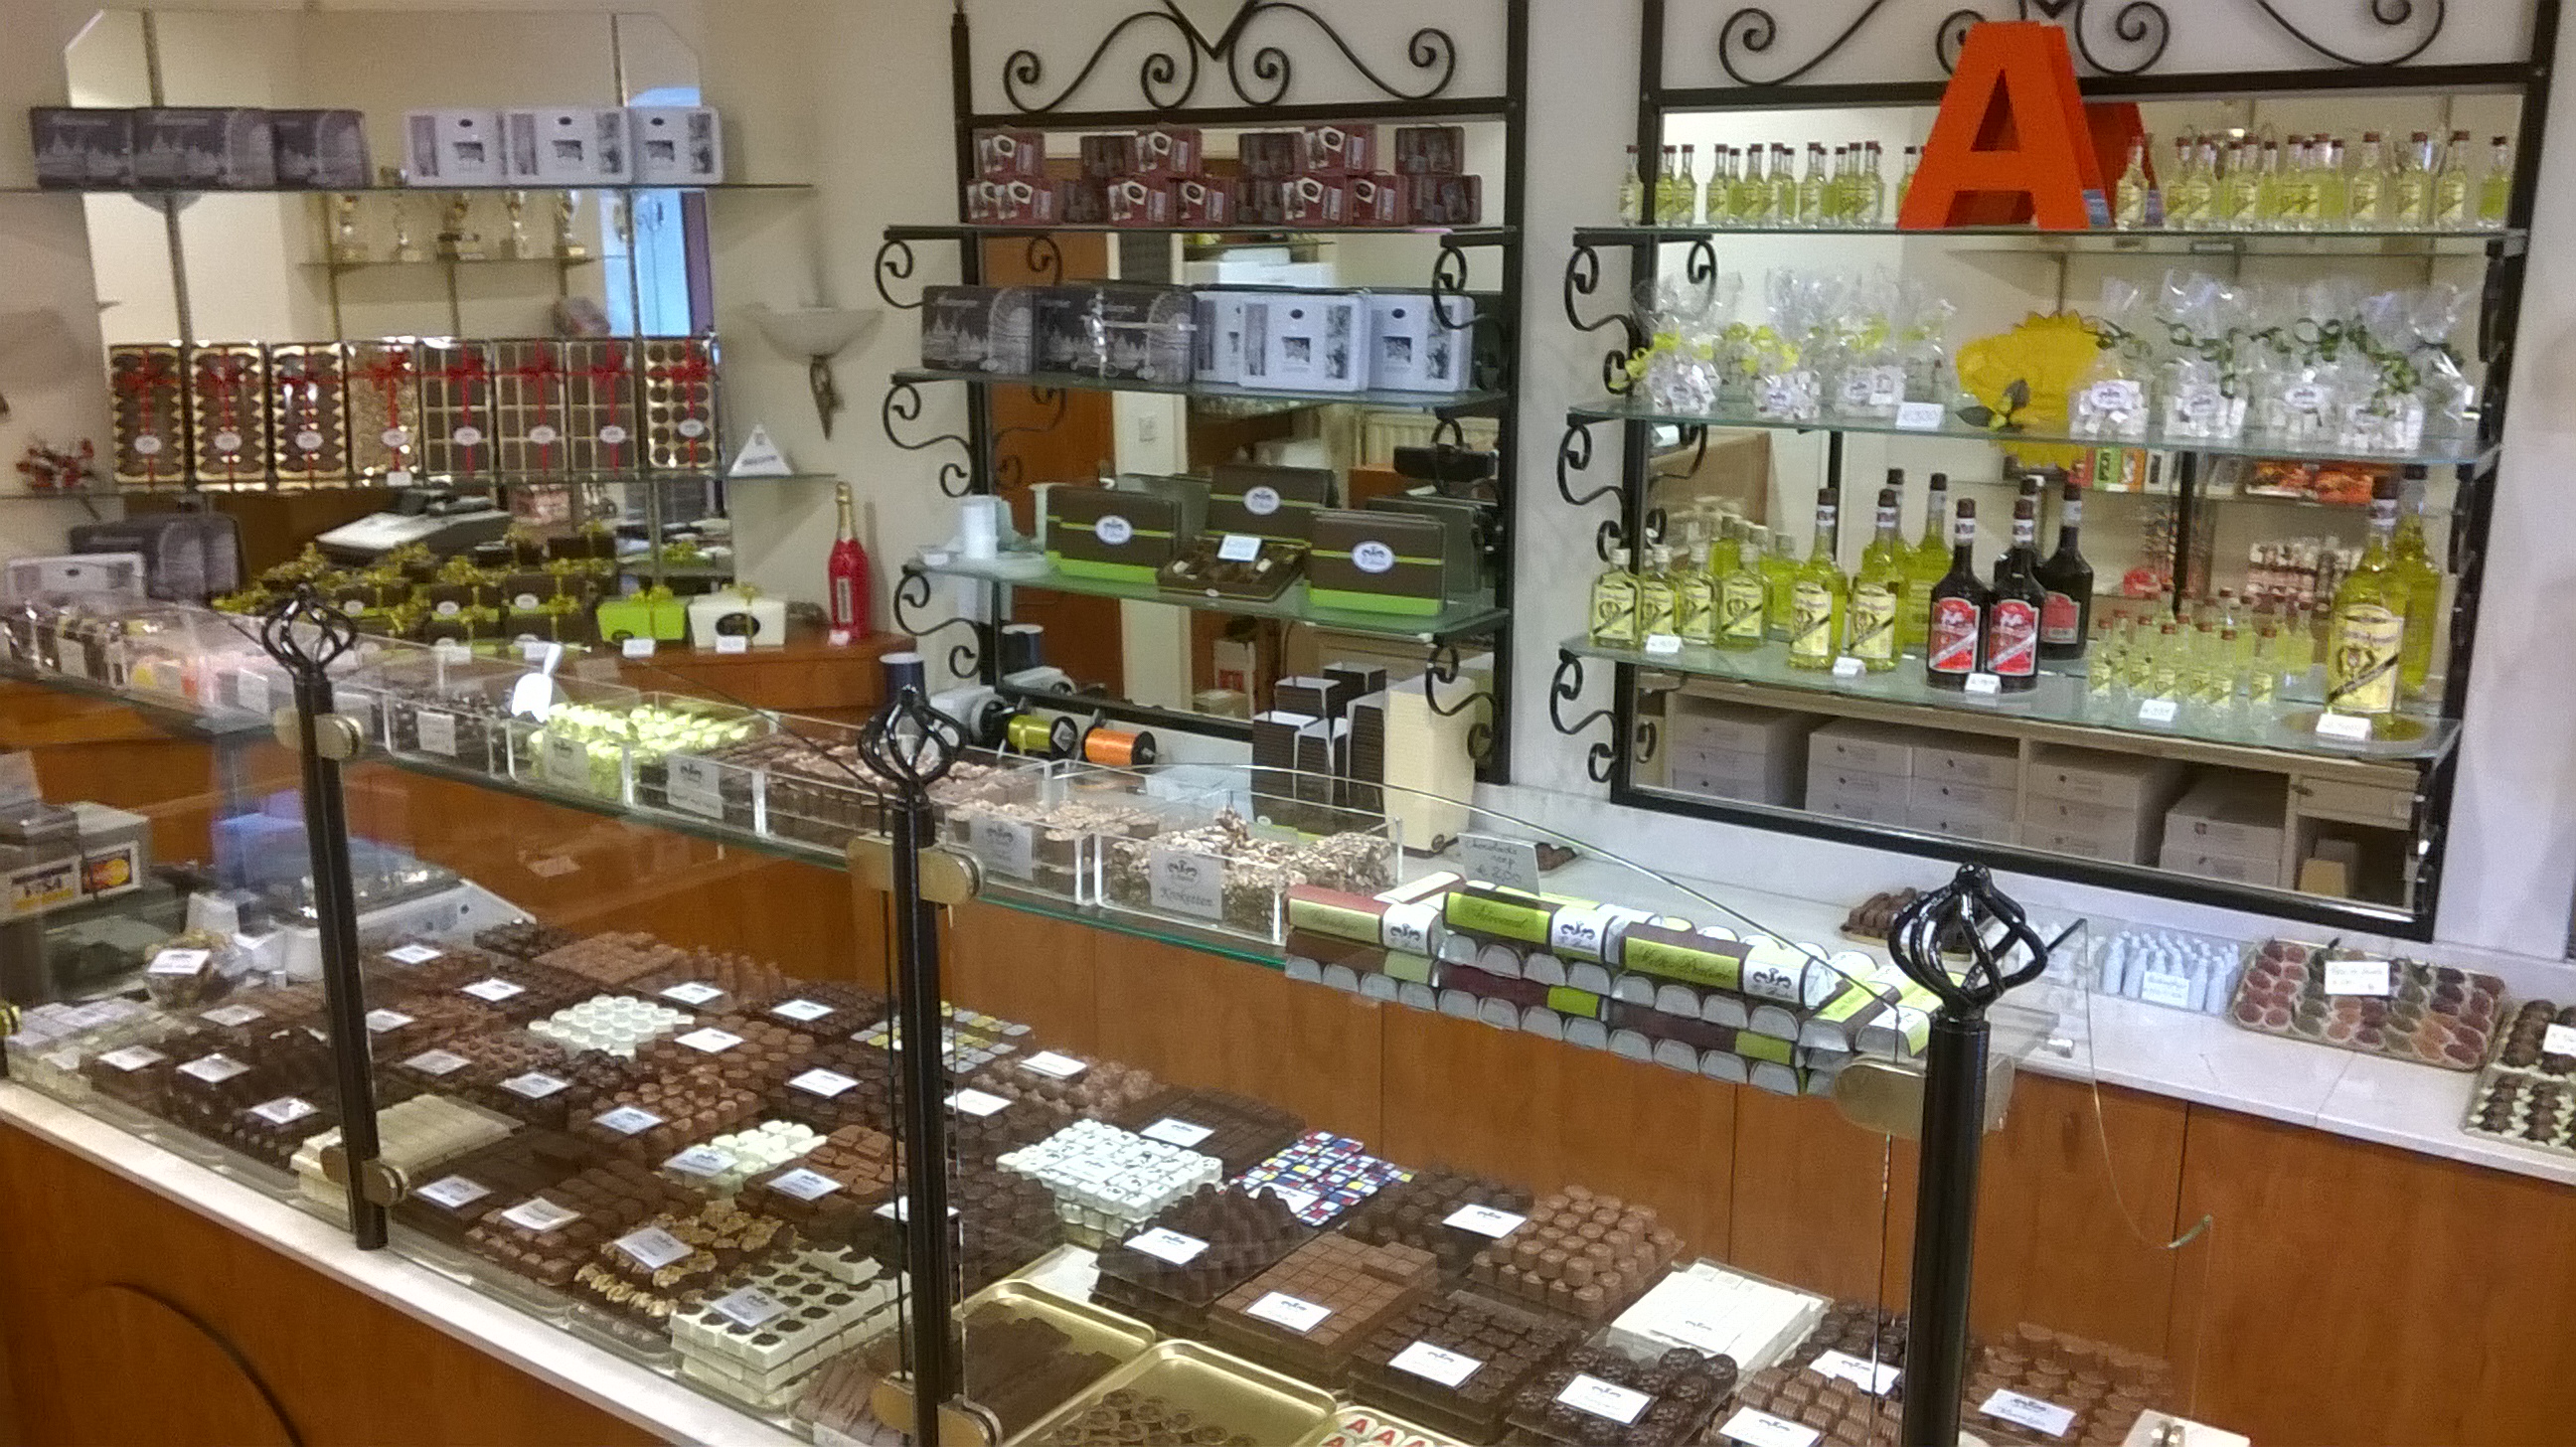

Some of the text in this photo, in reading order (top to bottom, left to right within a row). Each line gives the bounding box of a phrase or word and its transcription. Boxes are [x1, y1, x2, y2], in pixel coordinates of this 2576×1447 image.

[1895, 21, 2092, 231] A
[1345, 1418, 1368, 1434] A
[1372, 1429, 1395, 1446] A
